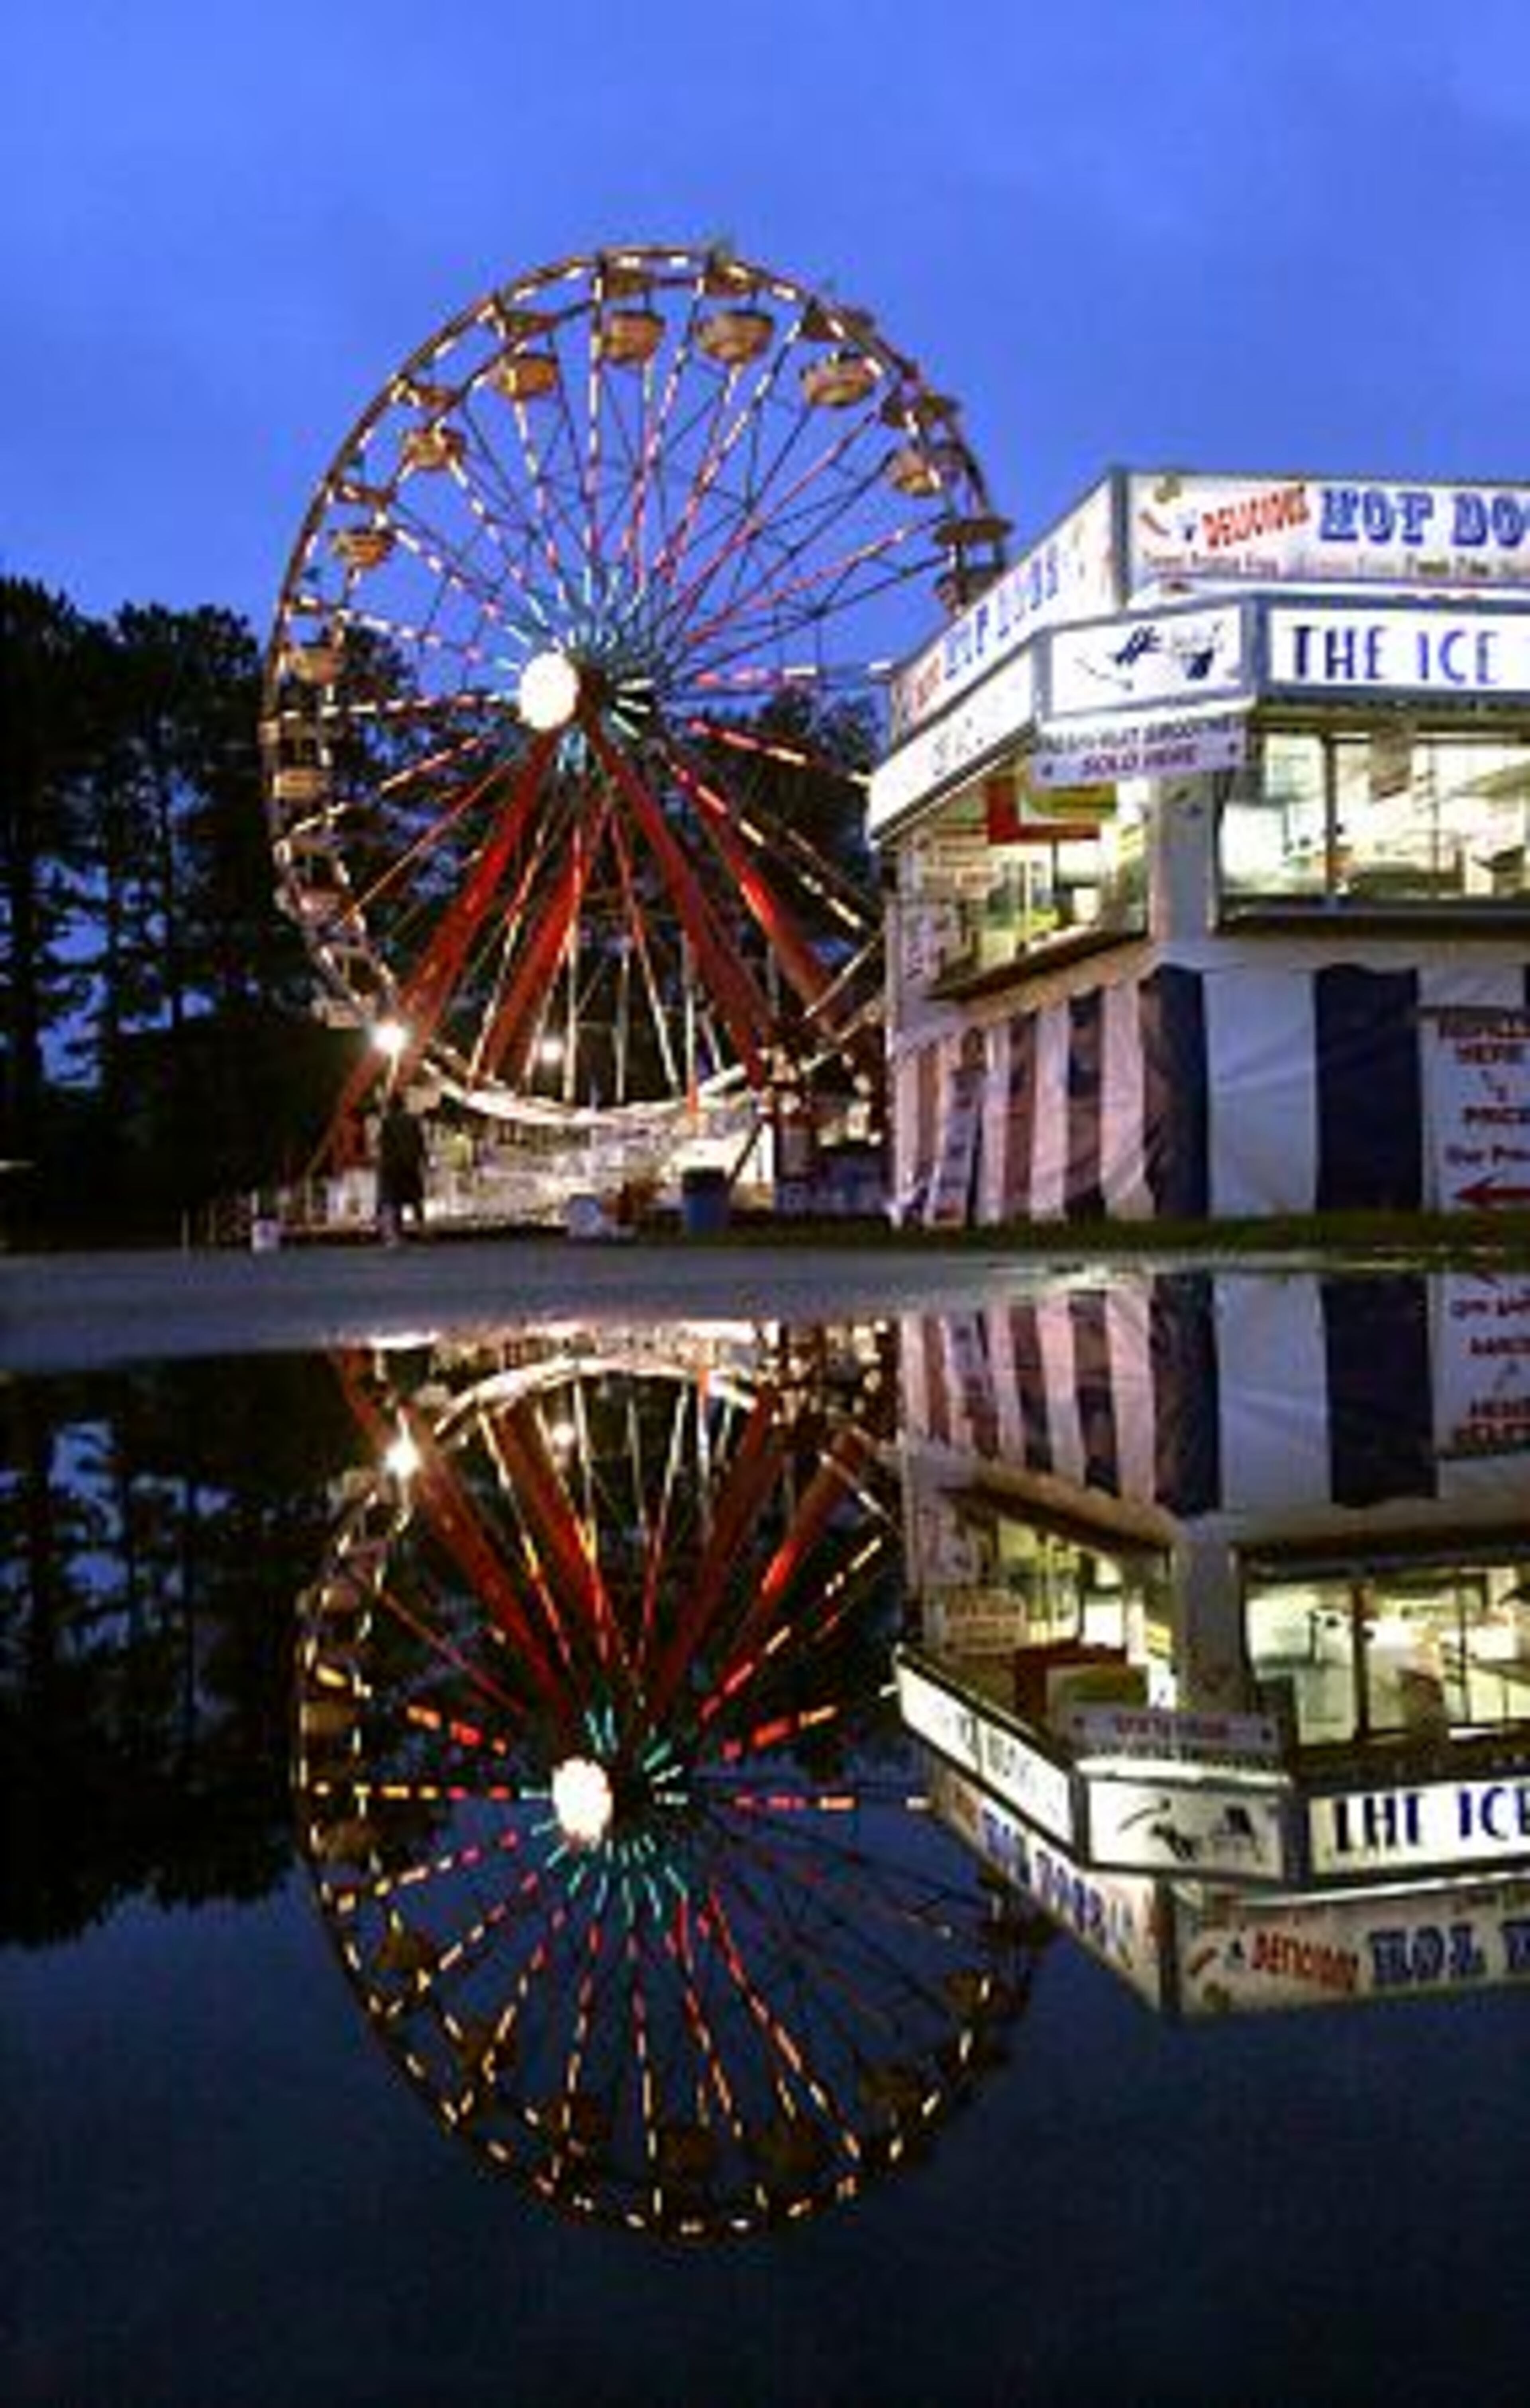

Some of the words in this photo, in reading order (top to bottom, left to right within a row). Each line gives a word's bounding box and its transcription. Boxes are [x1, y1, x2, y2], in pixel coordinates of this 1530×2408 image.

[1320, 489, 1433, 543] HOT
[1451, 492, 1530, 547] DO
[1292, 624, 1387, 682] THE
[1416, 630, 1498, 685] ICE
